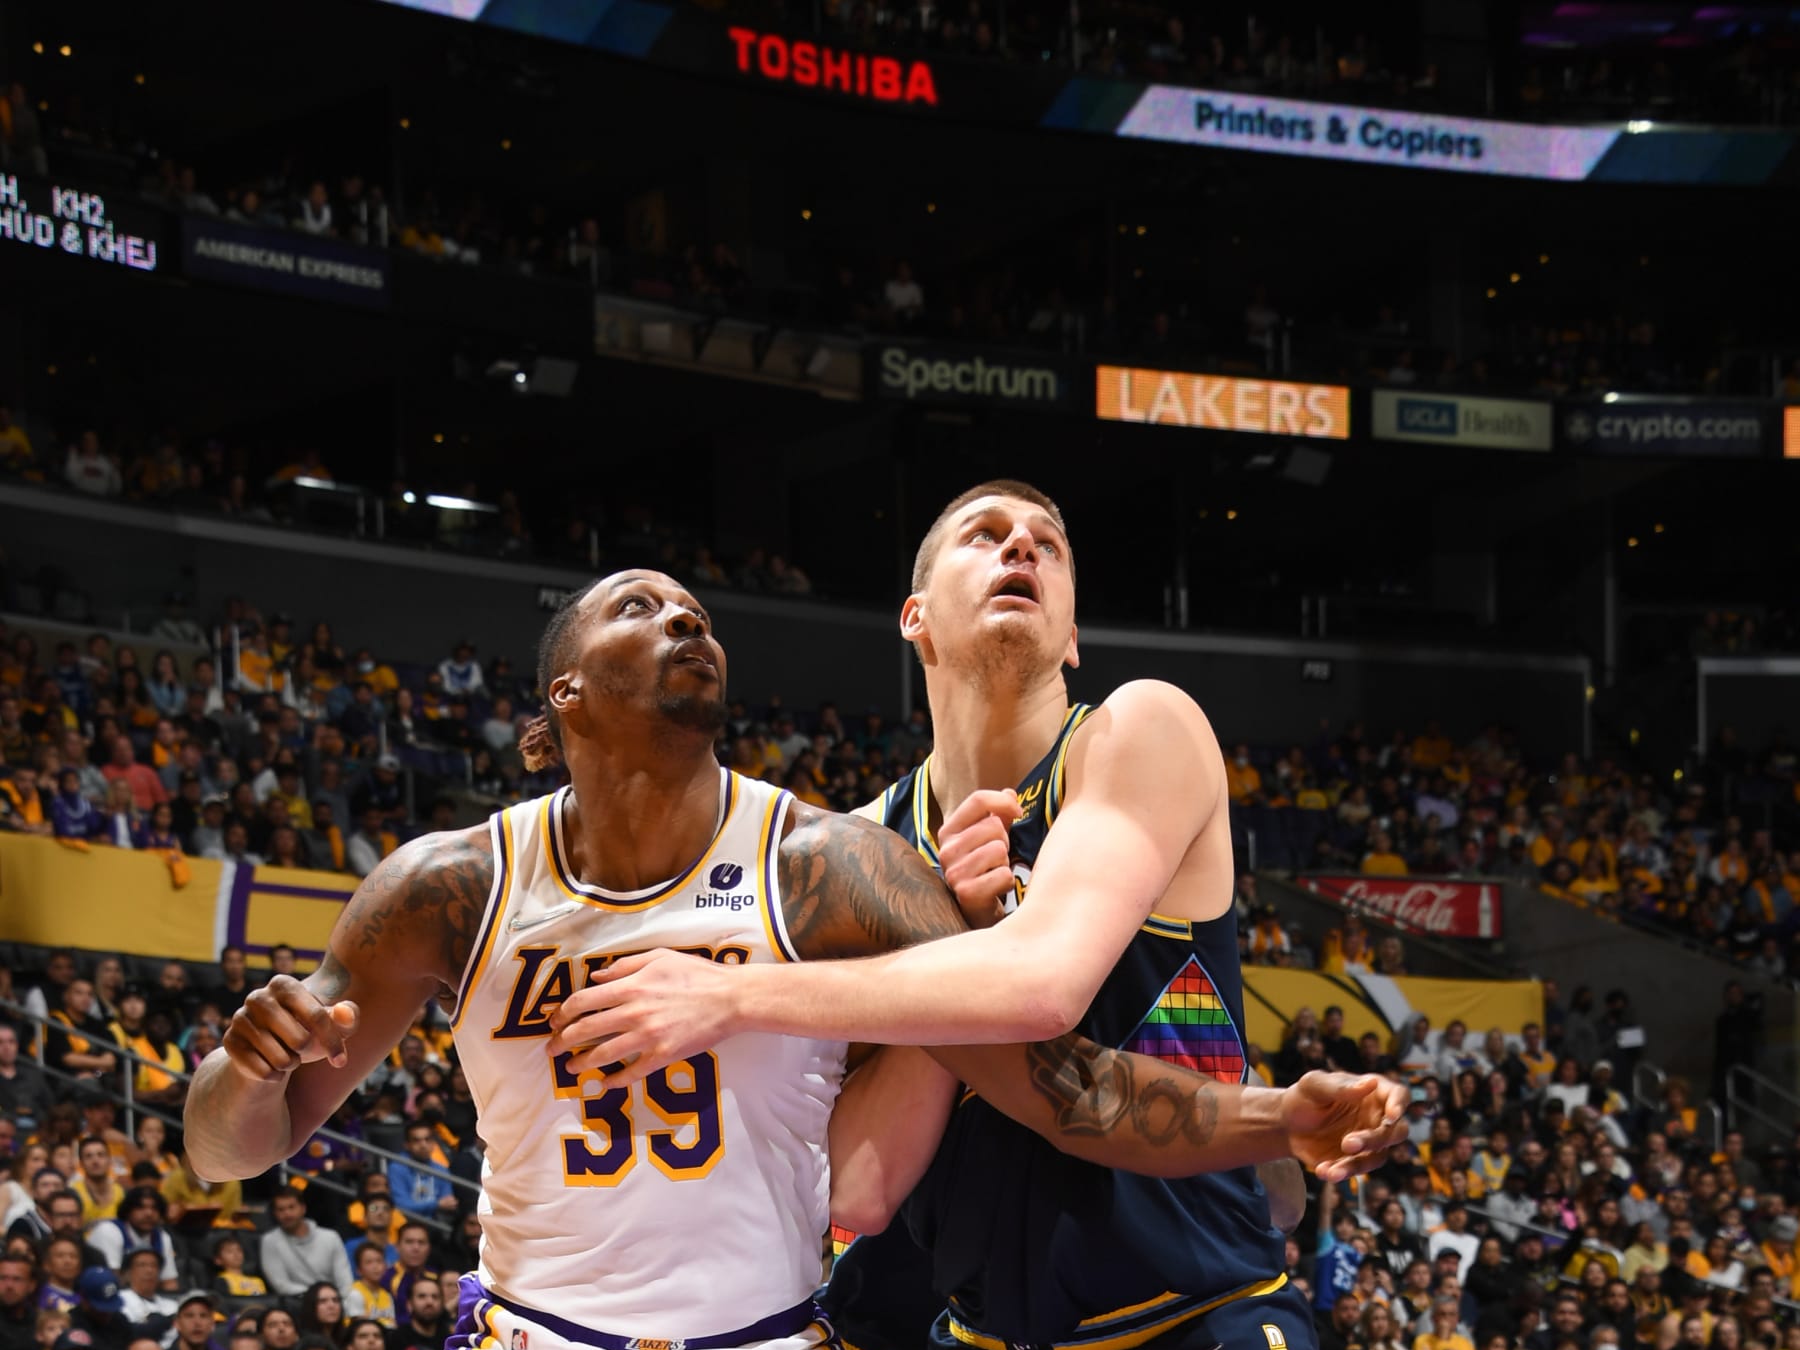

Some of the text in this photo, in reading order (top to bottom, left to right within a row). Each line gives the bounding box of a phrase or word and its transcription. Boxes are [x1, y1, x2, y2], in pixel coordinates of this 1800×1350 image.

[729, 26, 938, 107] TOSHIBA
[1195, 101, 1483, 159] Printers & Copiers
[60, 221, 83, 255] &
[195, 238, 384, 288] AMERICAN EXPRESS
[881, 348, 1056, 400] Spectrum
[1119, 367, 1335, 437] LAKERS
[1462, 408, 1531, 436] Health
[1596, 413, 1760, 444] crypto.com
[695, 892, 755, 912] bibigo
[549, 1045, 726, 1188] 39
